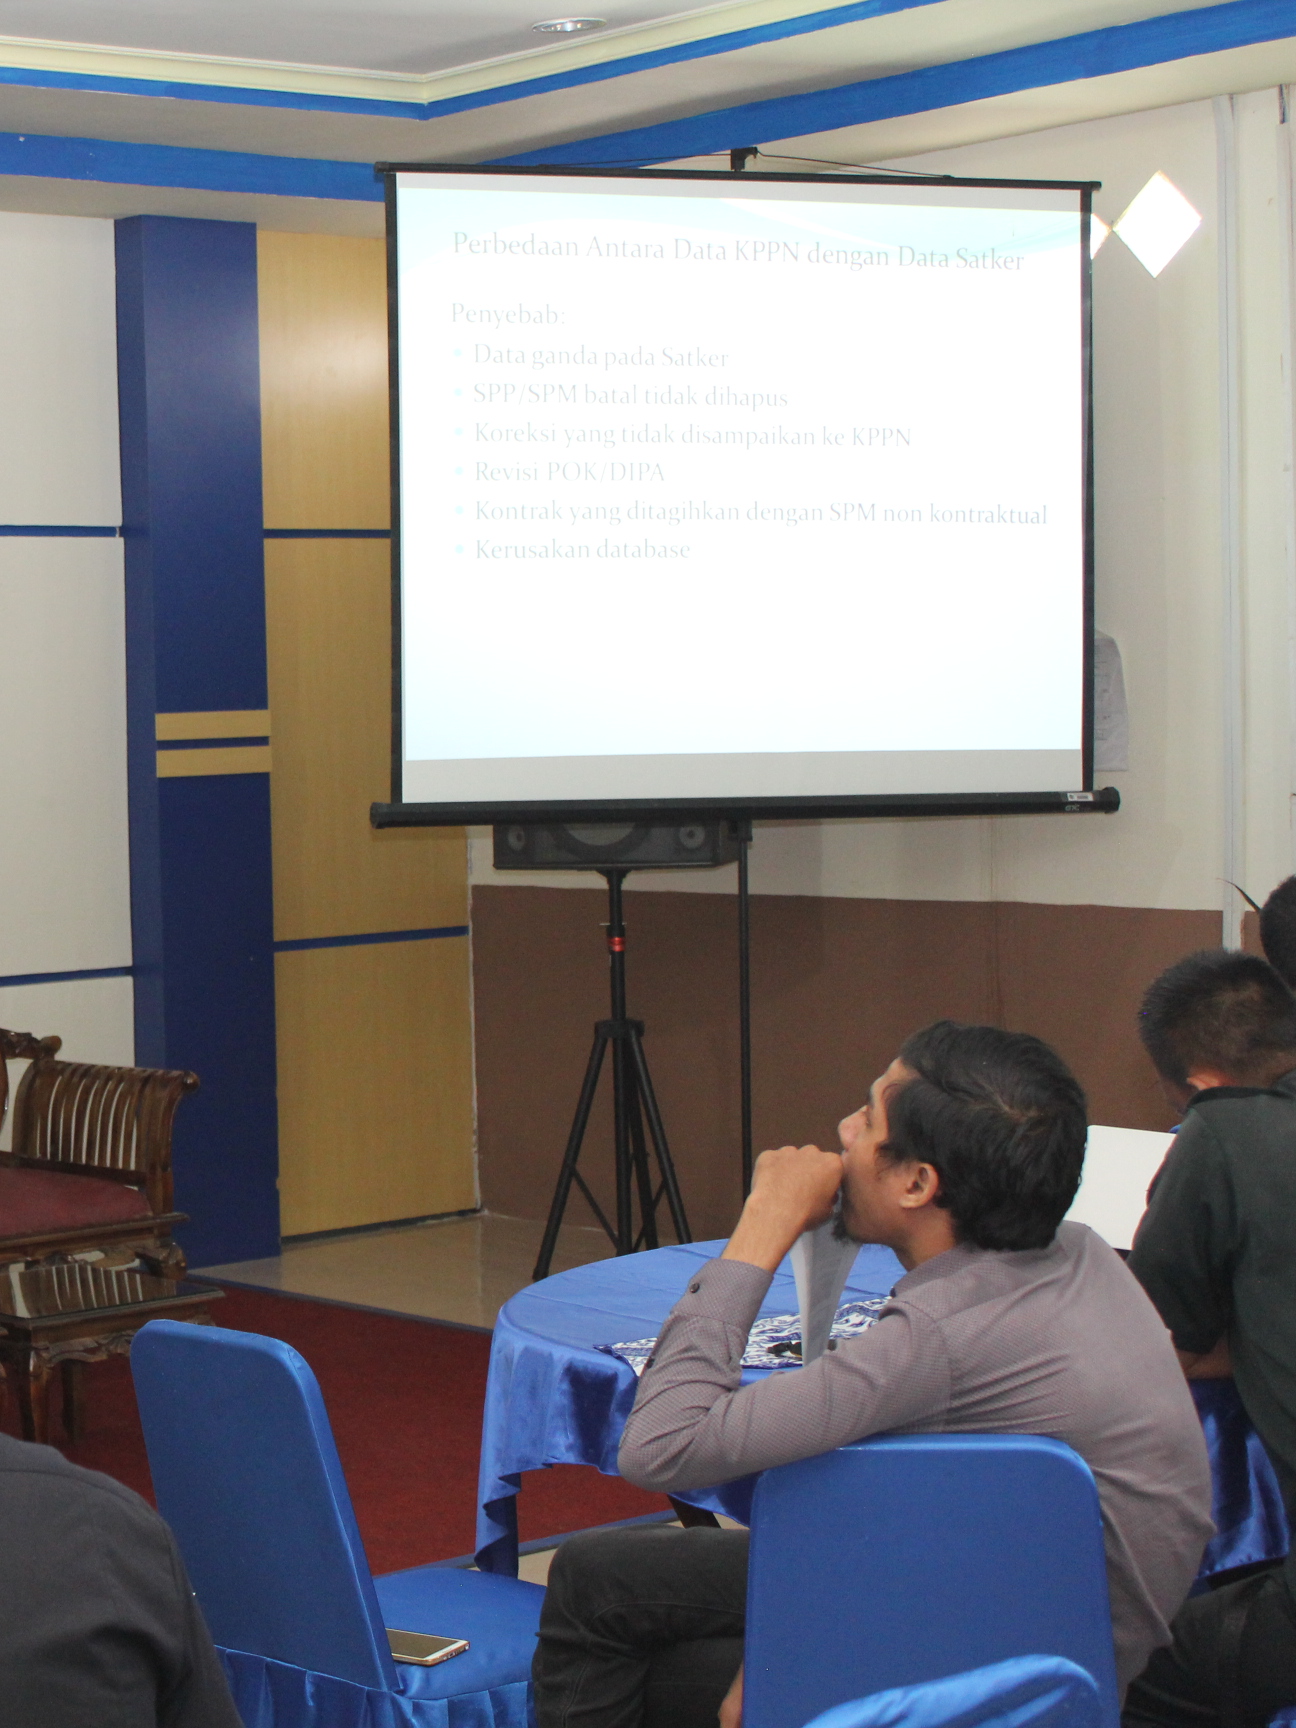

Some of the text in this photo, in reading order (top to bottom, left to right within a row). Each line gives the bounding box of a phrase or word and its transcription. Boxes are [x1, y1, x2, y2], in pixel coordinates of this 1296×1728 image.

[453, 231, 1024, 271] Perbedaan Antara Data KPPN dengan Data Satker
[452, 302, 566, 329] Penyebab:
[474, 343, 729, 372] Data ganda pada Satker
[473, 383, 788, 412] SPP/SPM batal tidak dihapus
[475, 421, 911, 451] Koreksi yang tidak disampaikan ke KPPN
[475, 461, 665, 482] Revisi POK/DIPA
[476, 499, 1047, 528] Kontrak yang ditagihkan dengan SPM non kontraktual
[476, 537, 691, 559] Kerusakan database
